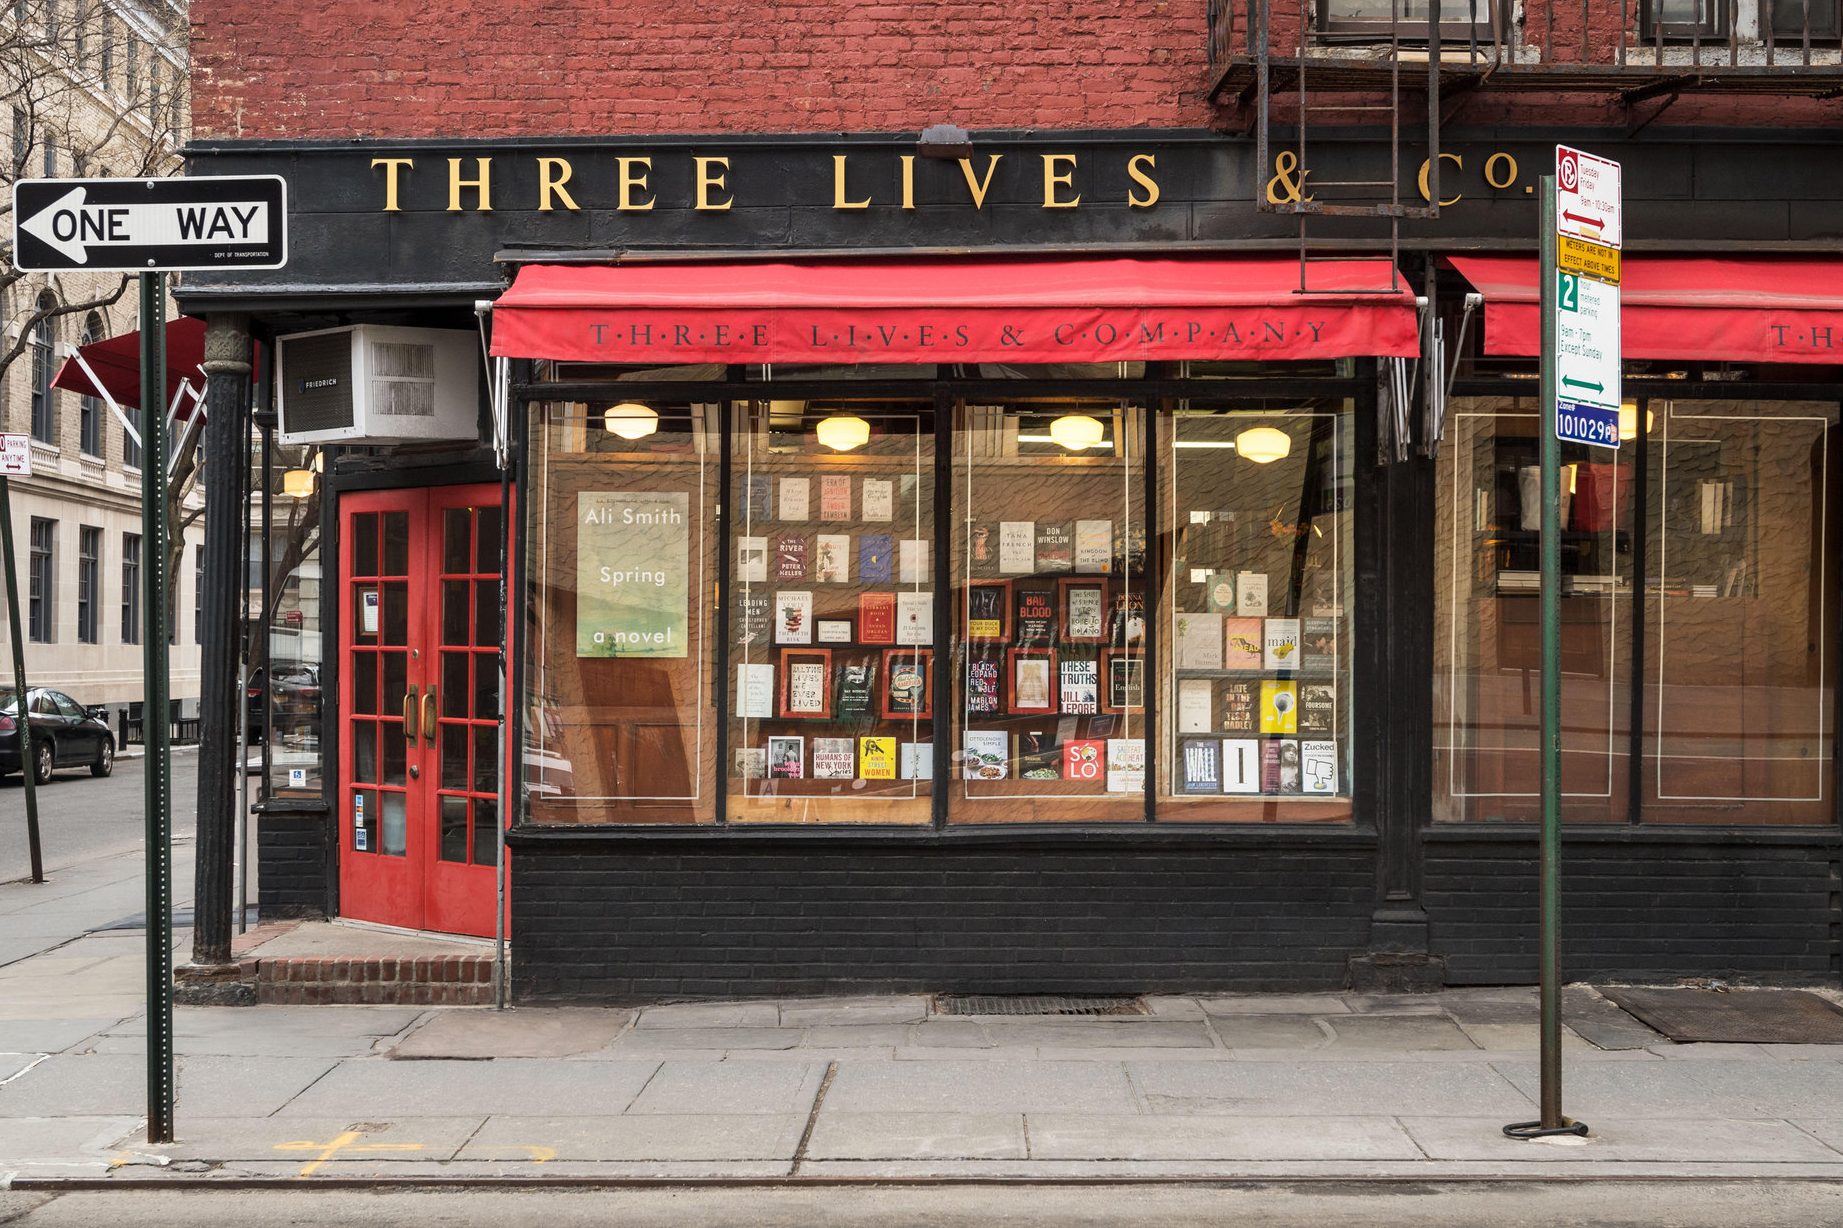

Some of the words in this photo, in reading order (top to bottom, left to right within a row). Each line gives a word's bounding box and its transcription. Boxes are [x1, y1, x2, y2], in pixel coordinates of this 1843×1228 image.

[1580, 163, 1599, 181] Tuesday
[371, 156, 734, 212] THREE
[832, 153, 1160, 210] LIVES
[1267, 151, 1317, 204] &
[1580, 177, 1594, 192] Friday
[1580, 195, 1591, 207] 9am
[52, 209, 130, 242] ONE
[176, 206, 259, 240] WAY
[1566, 239, 1585, 252] METERS
[1586, 245, 1596, 255] ARE
[1597, 248, 1606, 258] NOT
[1564, 254, 1583, 266] EFFECT
[1583, 260, 1600, 271] ABOVE
[1601, 263, 1615, 275] TIMES
[1563, 274, 1574, 308] 2
[1000, 324, 1024, 346] &
[1561, 324, 1573, 337] 9am
[1579, 328, 1592, 342] 7pm
[1561, 340, 1581, 356] Except
[1582, 344, 1603, 360] Sunday
[305, 379, 337, 388] FRIEDRICH
[1559, 401, 1576, 411] Zone#
[1559, 413, 1605, 440] 101029
[7, 440, 26, 449] PARKING
[2, 454, 25, 463] ANYTIME
[585, 507, 613, 525] Ali
[623, 507, 681, 525] Smith
[1038, 536, 1069, 544] WINSLOW
[779, 544, 803, 552] RIVER
[600, 566, 666, 587] Spring
[1026, 596, 1045, 606] BAD
[1020, 606, 1051, 618] BLOOD
[593, 631, 605, 644] a
[614, 627, 672, 644] novel
[1267, 635, 1297, 647] maid
[972, 663, 995, 671] BLACK
[1061, 661, 1090, 672] THESE
[1061, 673, 1098, 685] TRUTHS
[1230, 684, 1248, 693] LATE
[970, 696, 998, 704] MARLON
[1061, 691, 1080, 703] JILL
[793, 699, 821, 707] LIVED
[968, 704, 989, 712] JAMES
[1231, 703, 1246, 711] DAY
[1305, 701, 1333, 709] FOURSOME
[1061, 703, 1095, 715] LEPORE
[1225, 711, 1251, 721] TESSA
[1223, 720, 1253, 730] HADLEY
[1304, 743, 1335, 751] Zucked
[815, 753, 843, 761] HUMANS
[844, 753, 852, 762] OF
[815, 761, 832, 770] NEW
[833, 761, 852, 770] YORK
[1185, 748, 1217, 782] WALL
[864, 768, 891, 776] WOMEN
